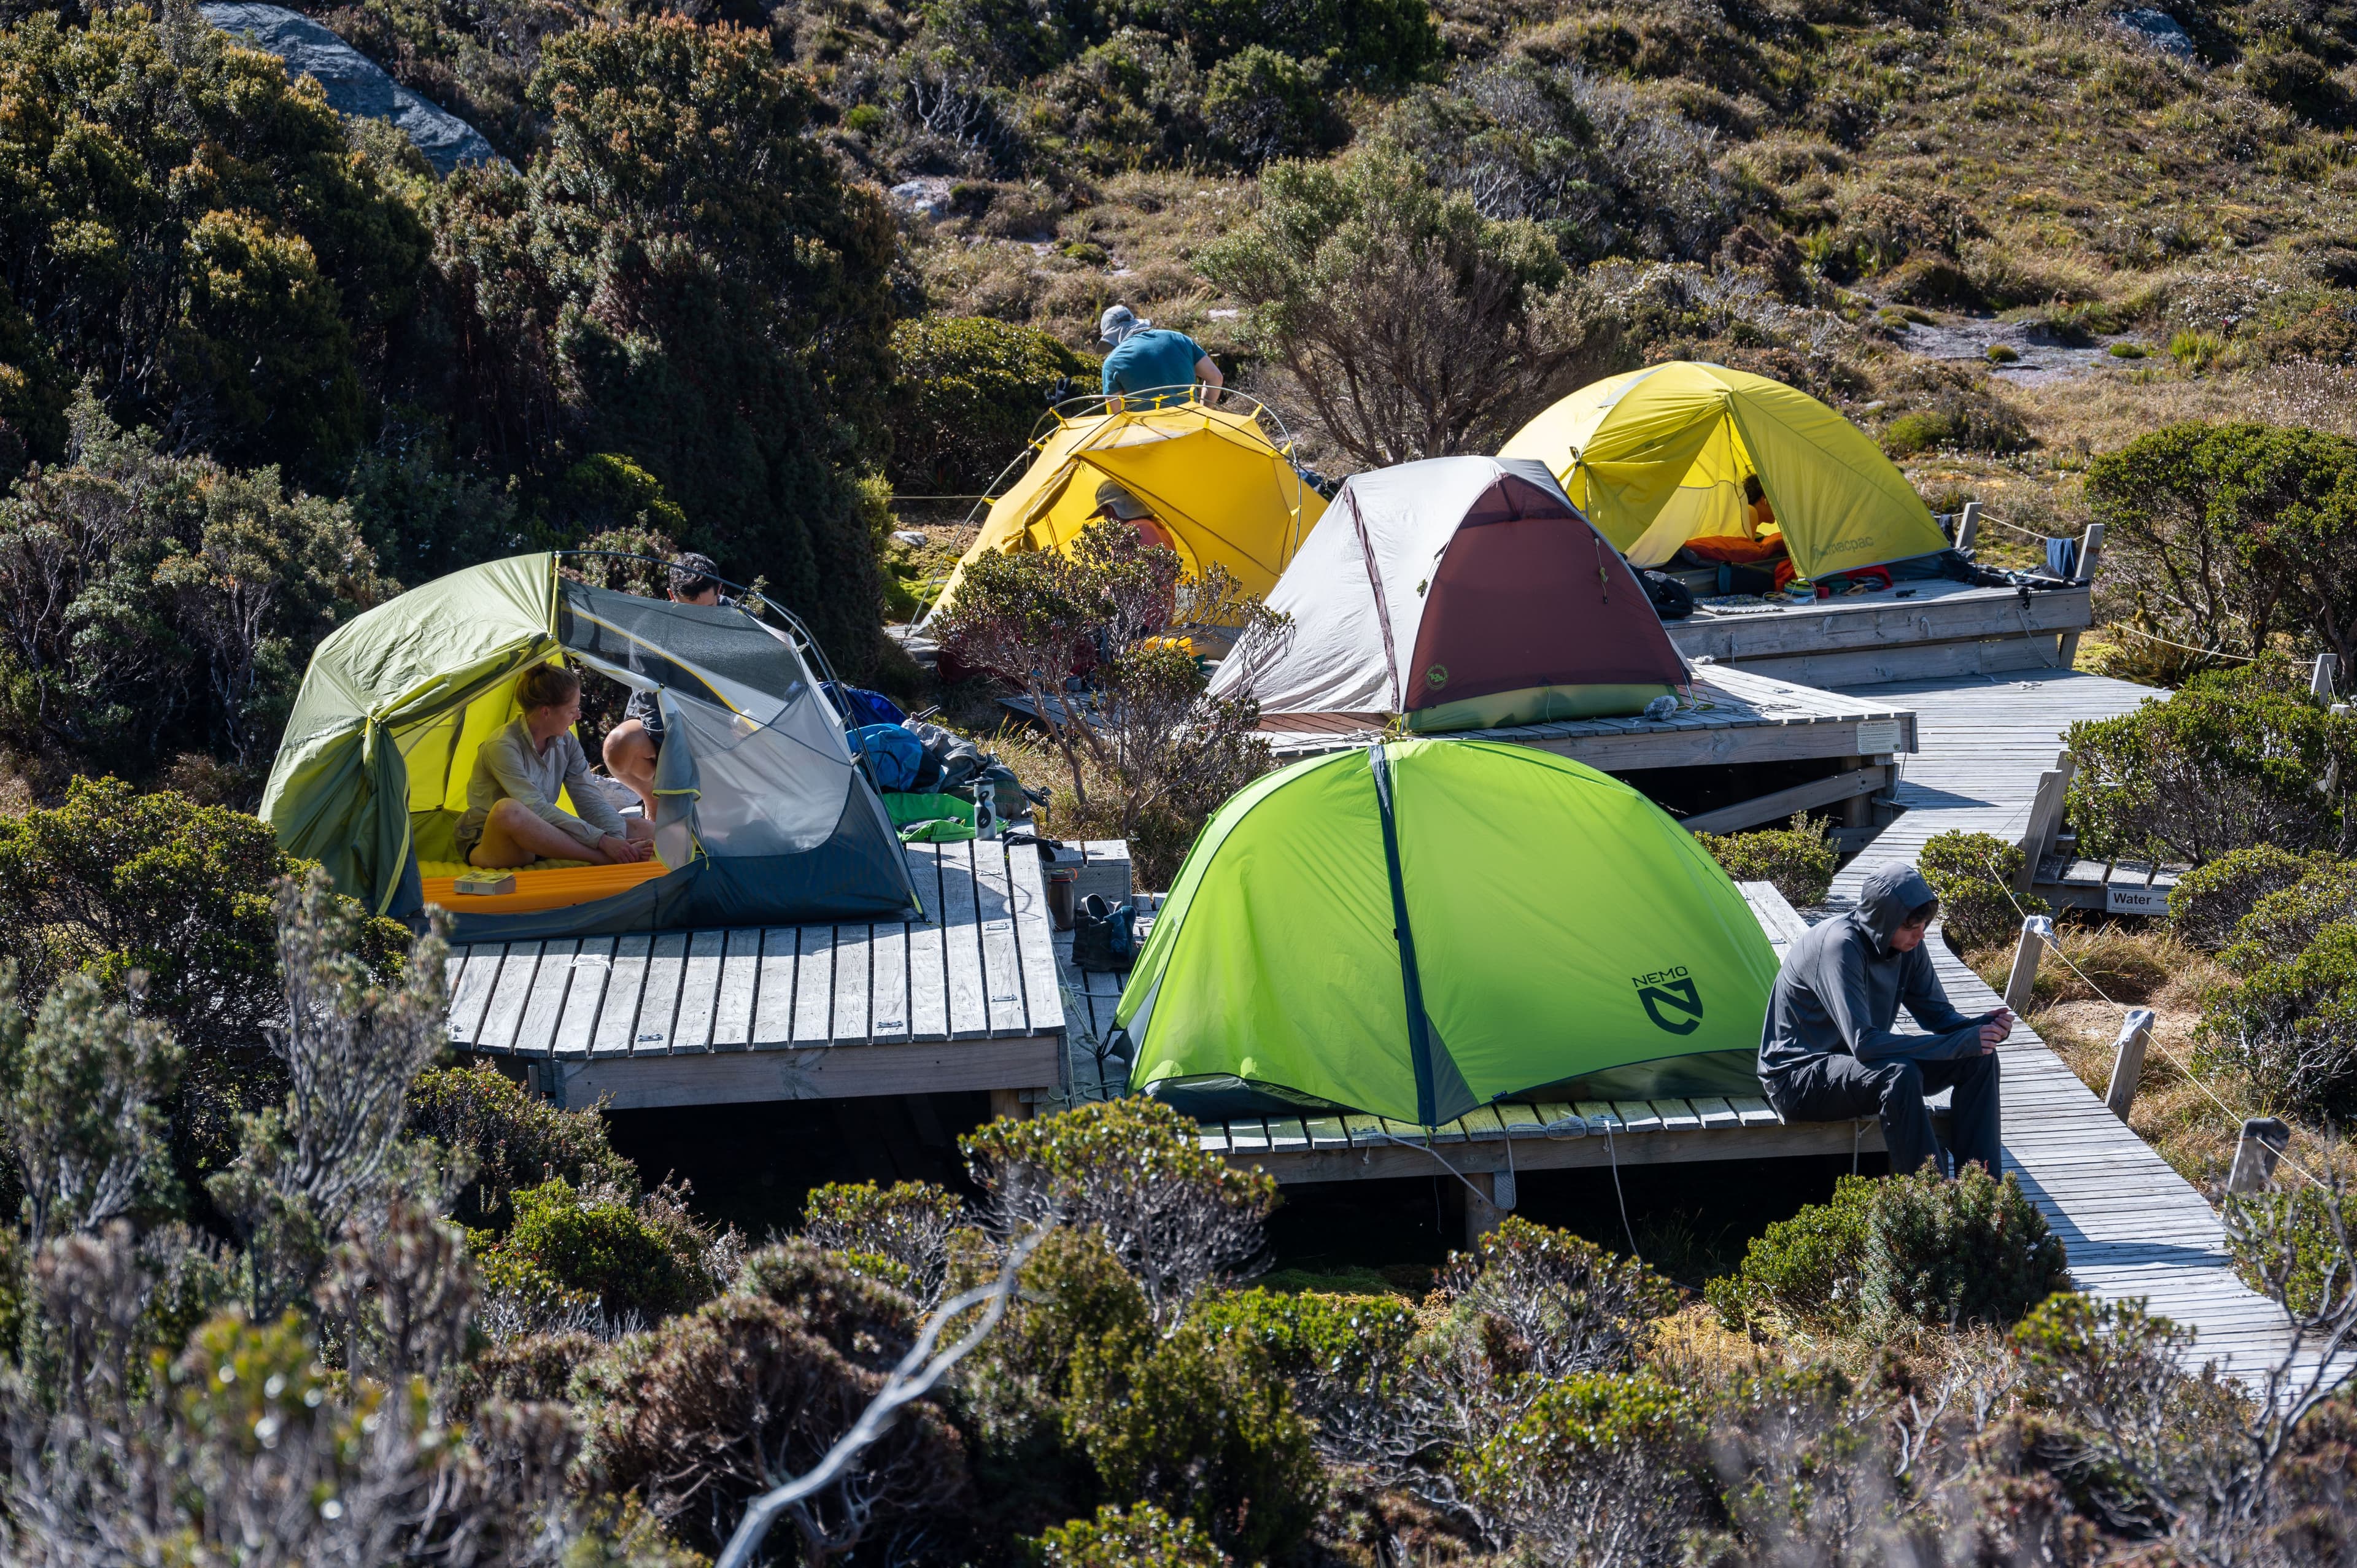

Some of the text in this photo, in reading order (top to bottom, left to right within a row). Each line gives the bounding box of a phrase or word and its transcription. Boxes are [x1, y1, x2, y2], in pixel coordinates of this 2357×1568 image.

[1826, 536, 1874, 555] macpac
[2113, 893, 2151, 905] Water
[1631, 966, 1689, 987] NEMO
